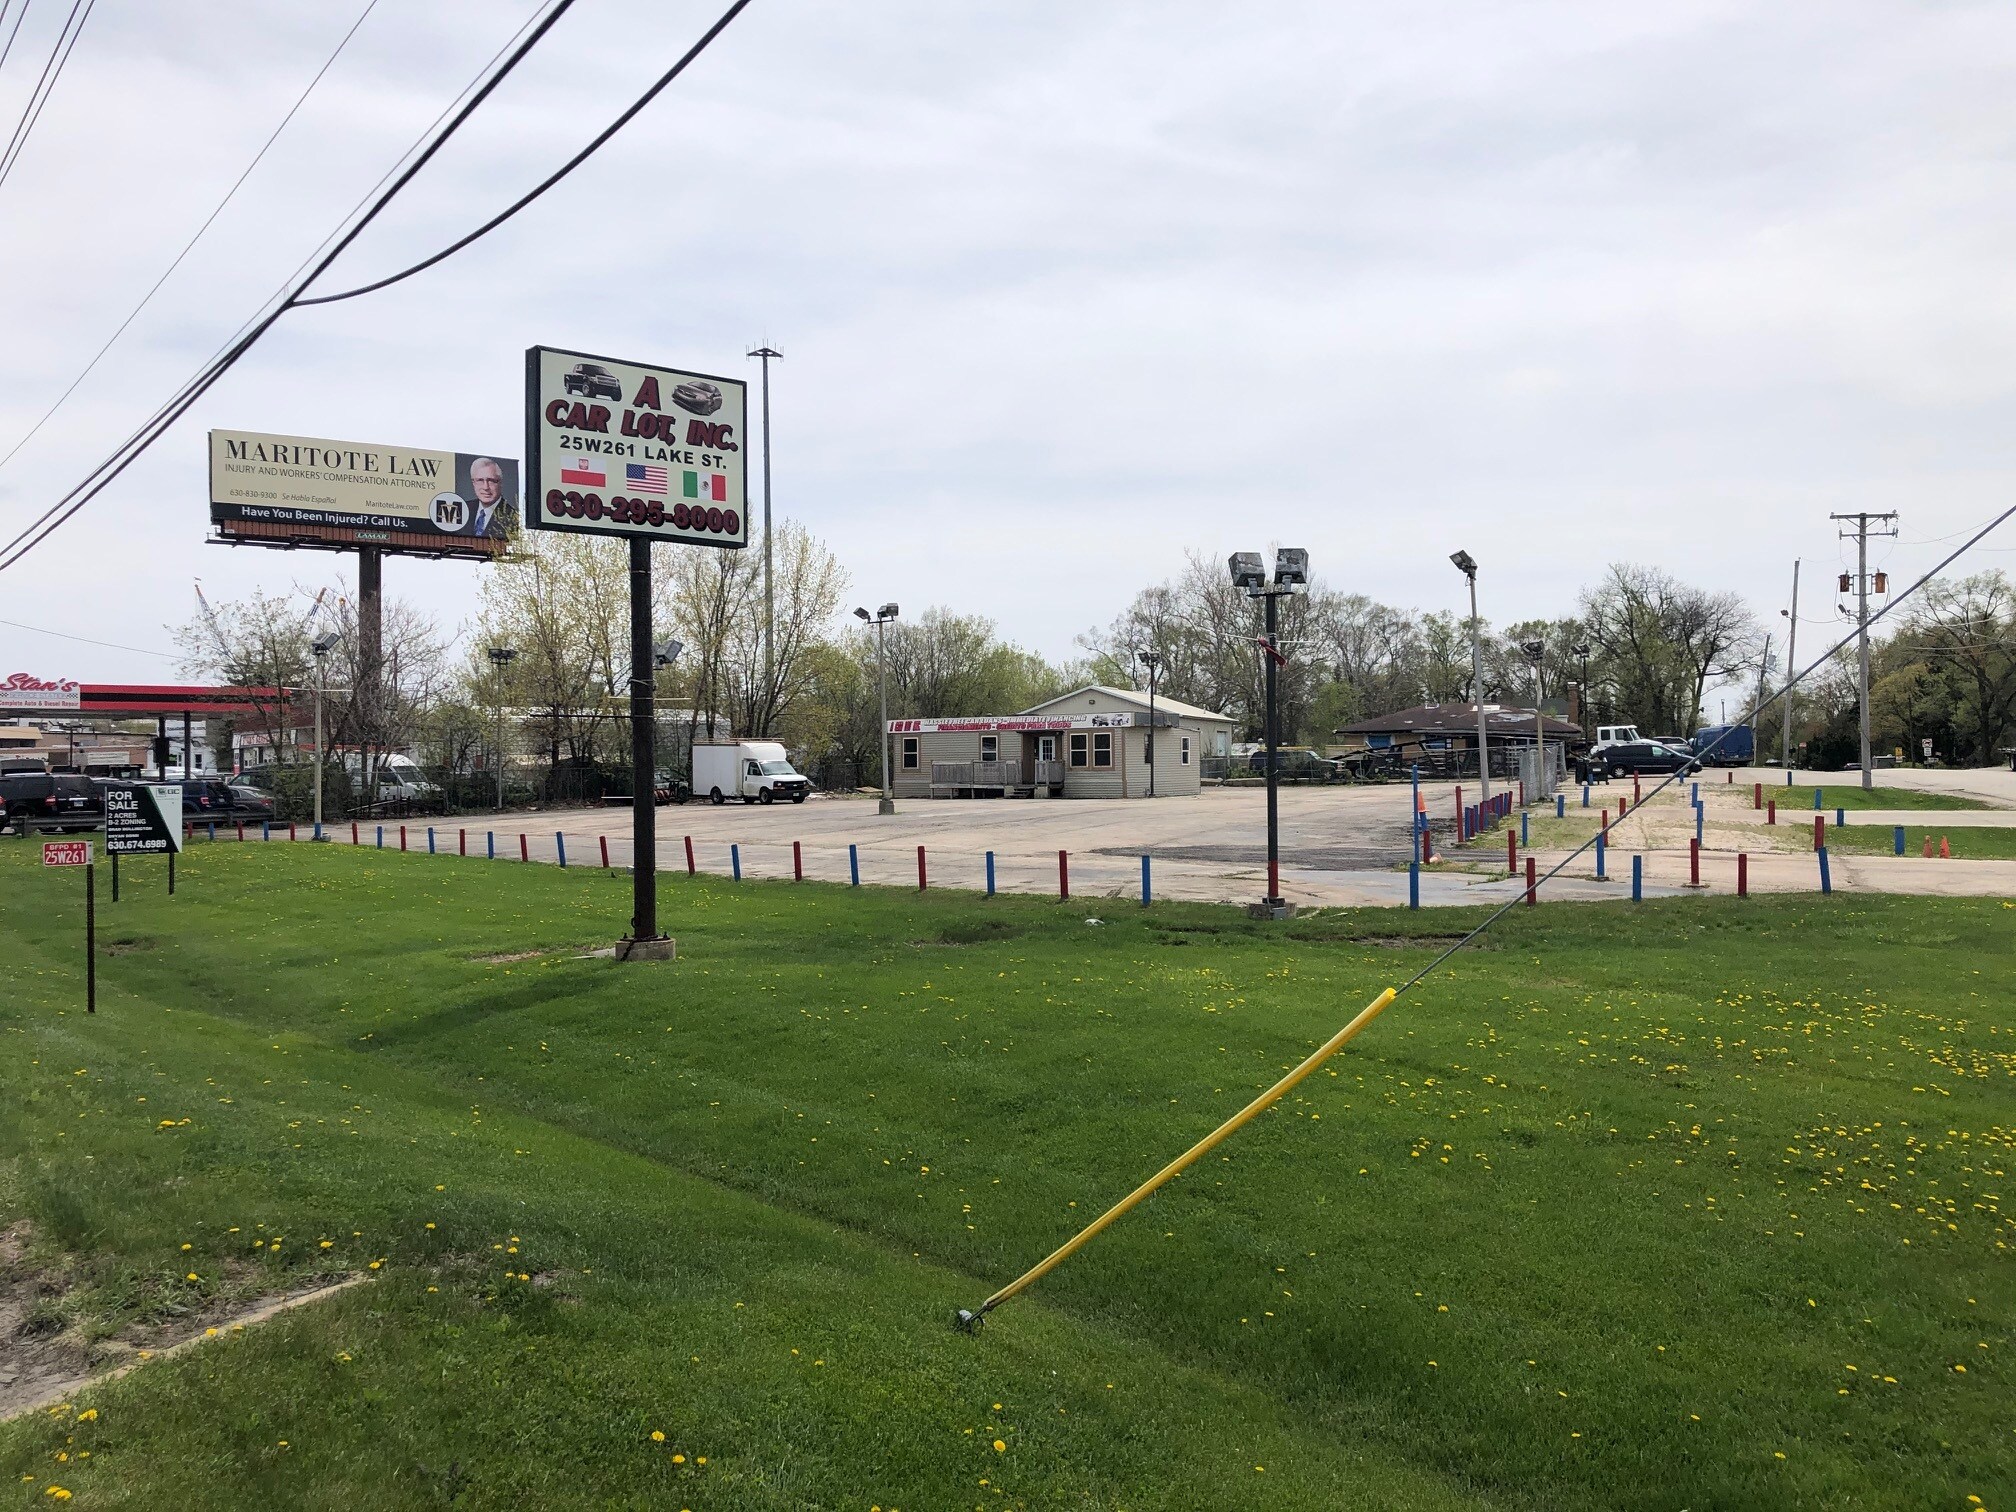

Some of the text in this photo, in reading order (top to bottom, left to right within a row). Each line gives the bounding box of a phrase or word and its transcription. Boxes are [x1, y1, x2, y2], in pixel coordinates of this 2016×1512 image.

[633, 376, 661, 410] A
[546, 399, 738, 452] CAR LOT, INC.
[225, 439, 442, 478] MARITOTE LAW
[560, 435, 726, 469] 25W261 LAKE ST.
[225, 464, 256, 474] INJURY
[258, 467, 278, 476] AND
[323, 473, 388, 486] COMPENSATION
[391, 478, 435, 490] ATTORNEYS
[230, 489, 277, 499] 630-830-9300
[291, 494, 310, 502] Hablo
[312, 496, 336, 504] Español
[365, 500, 420, 511] MaritoteLaw.com
[242, 506, 408, 528] Have You Been Injured? Call Us.
[546, 489, 740, 535] 630-295-8000
[0, 673, 78, 692] Stan's
[108, 792, 132, 800] FOR
[108, 801, 138, 810] SALE
[108, 840, 166, 850] 630.674.6989
[45, 850, 85, 864] 25W261
